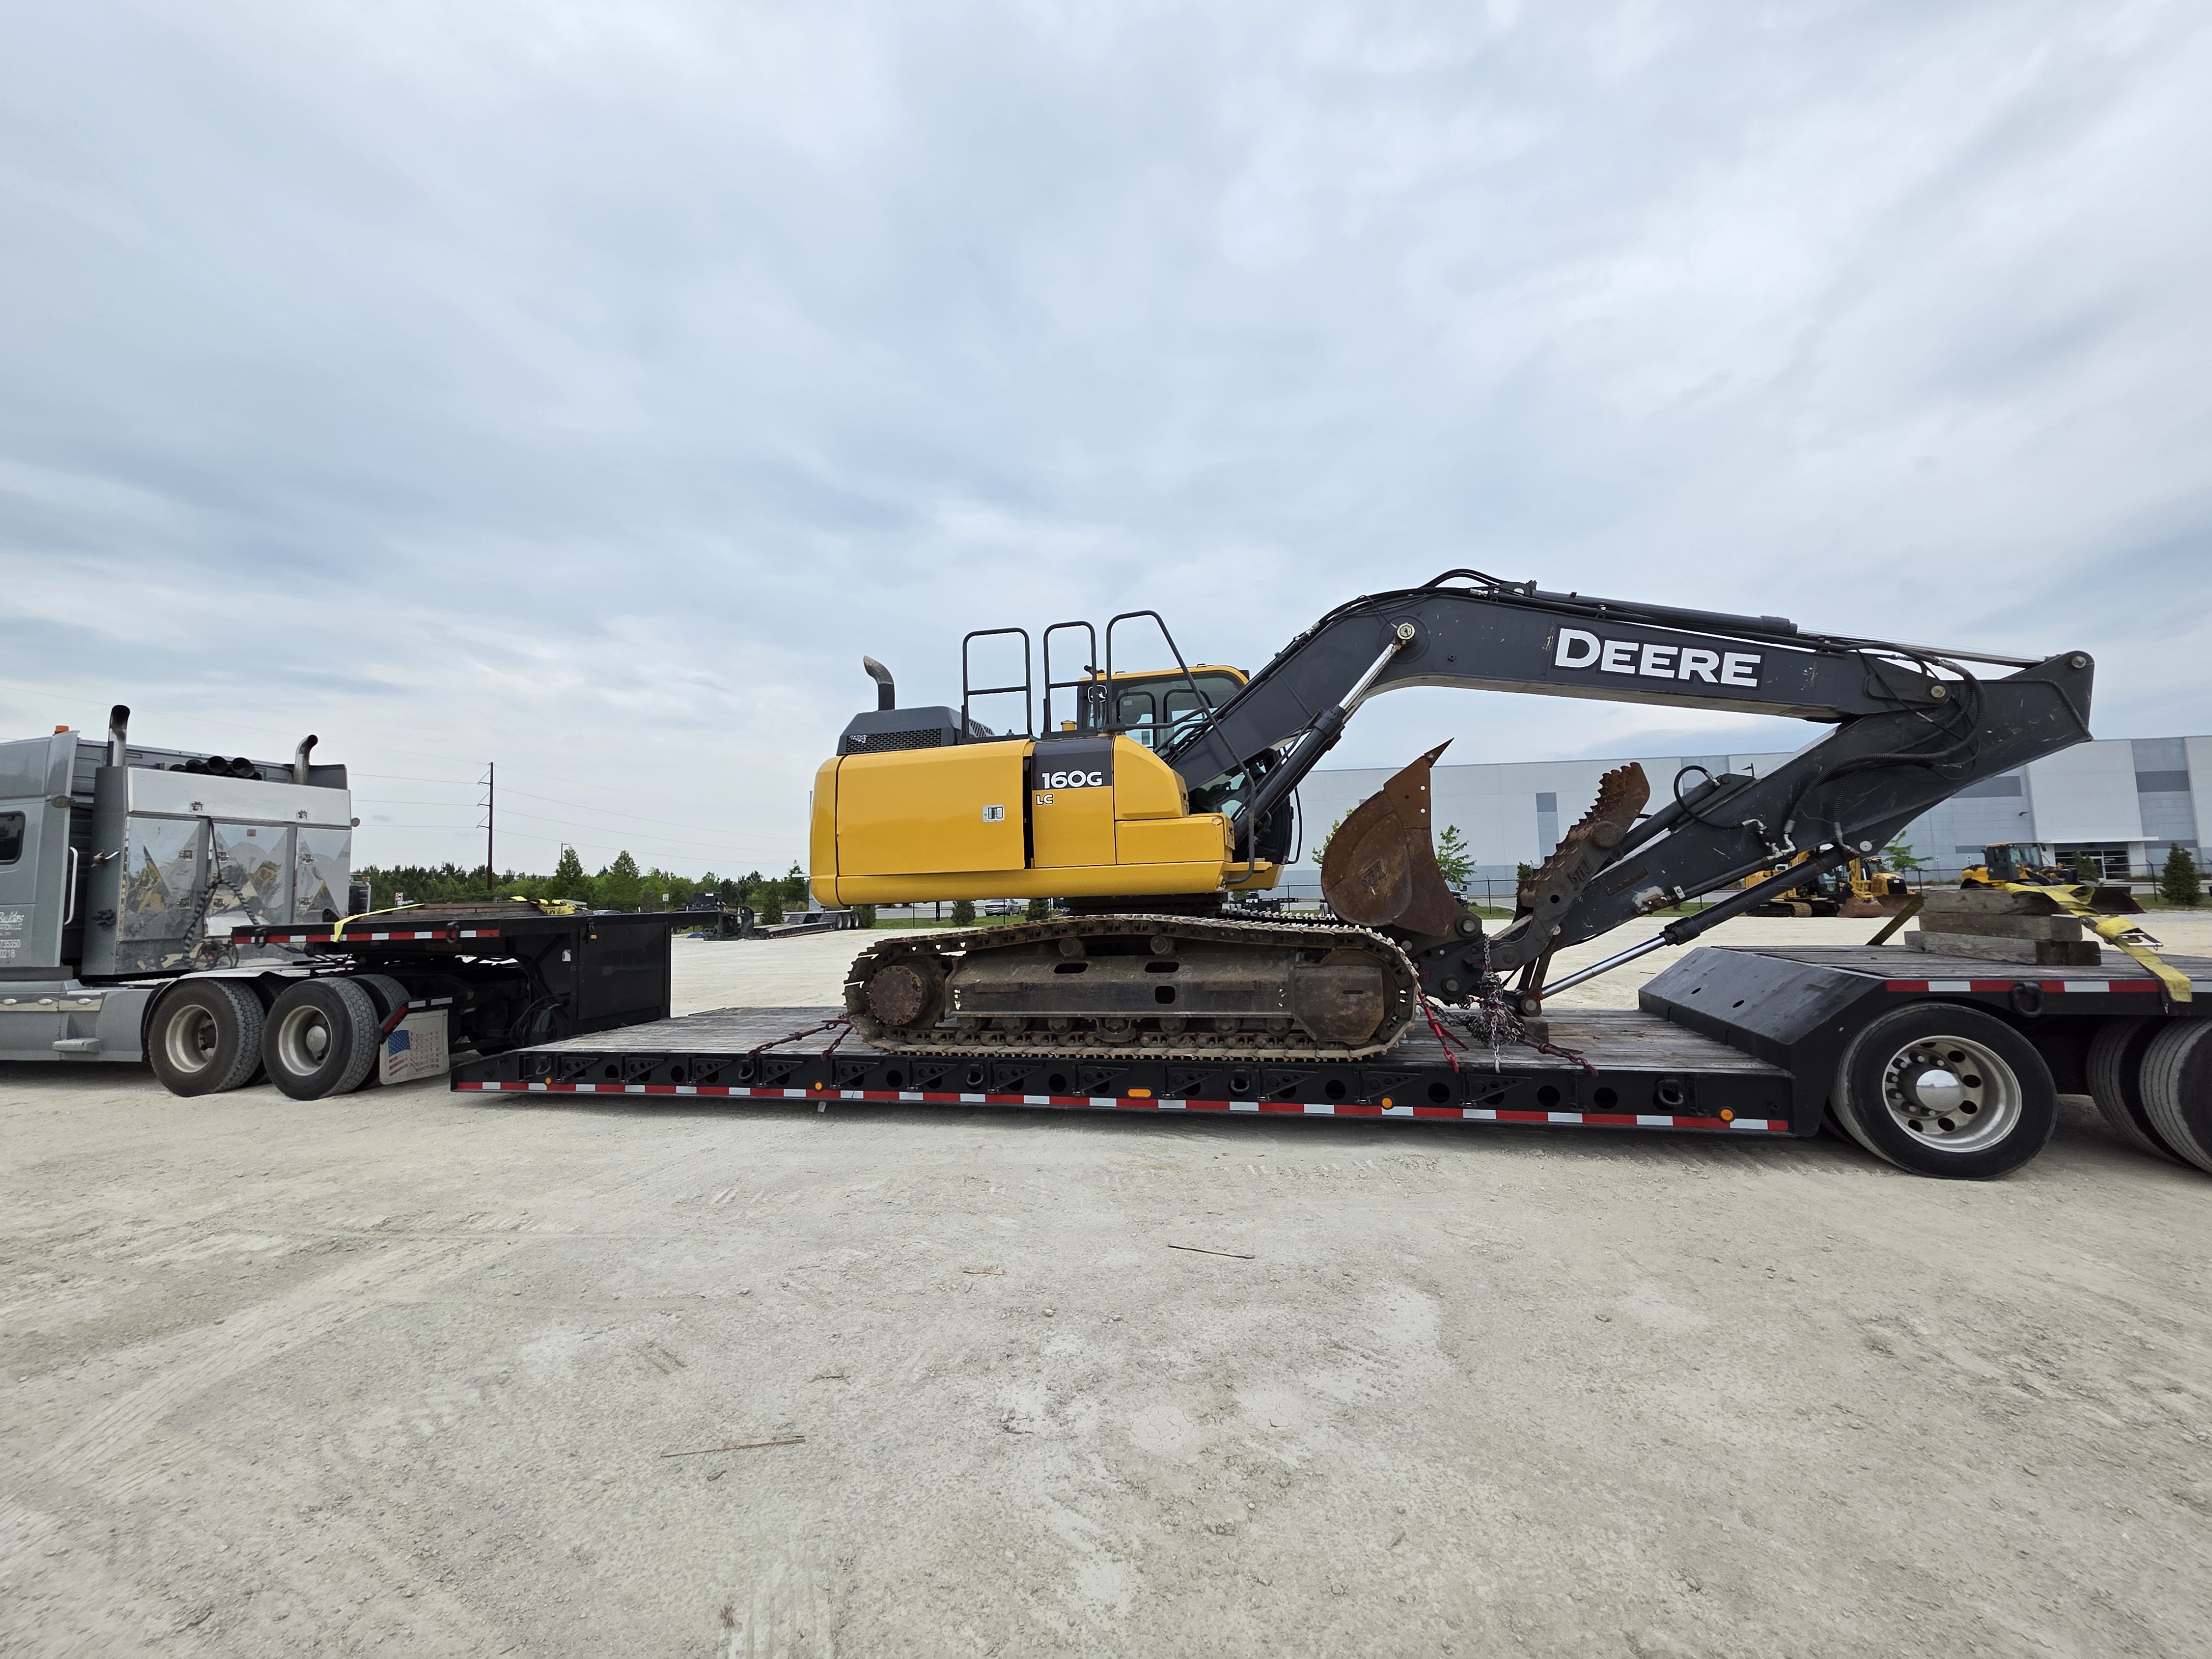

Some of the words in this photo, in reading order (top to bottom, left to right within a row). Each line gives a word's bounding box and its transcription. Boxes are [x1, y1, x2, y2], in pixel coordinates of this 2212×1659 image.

[1554, 628, 1761, 687] DEERE
[1042, 770, 1103, 789] 160G
[1036, 794, 1054, 805] LC
